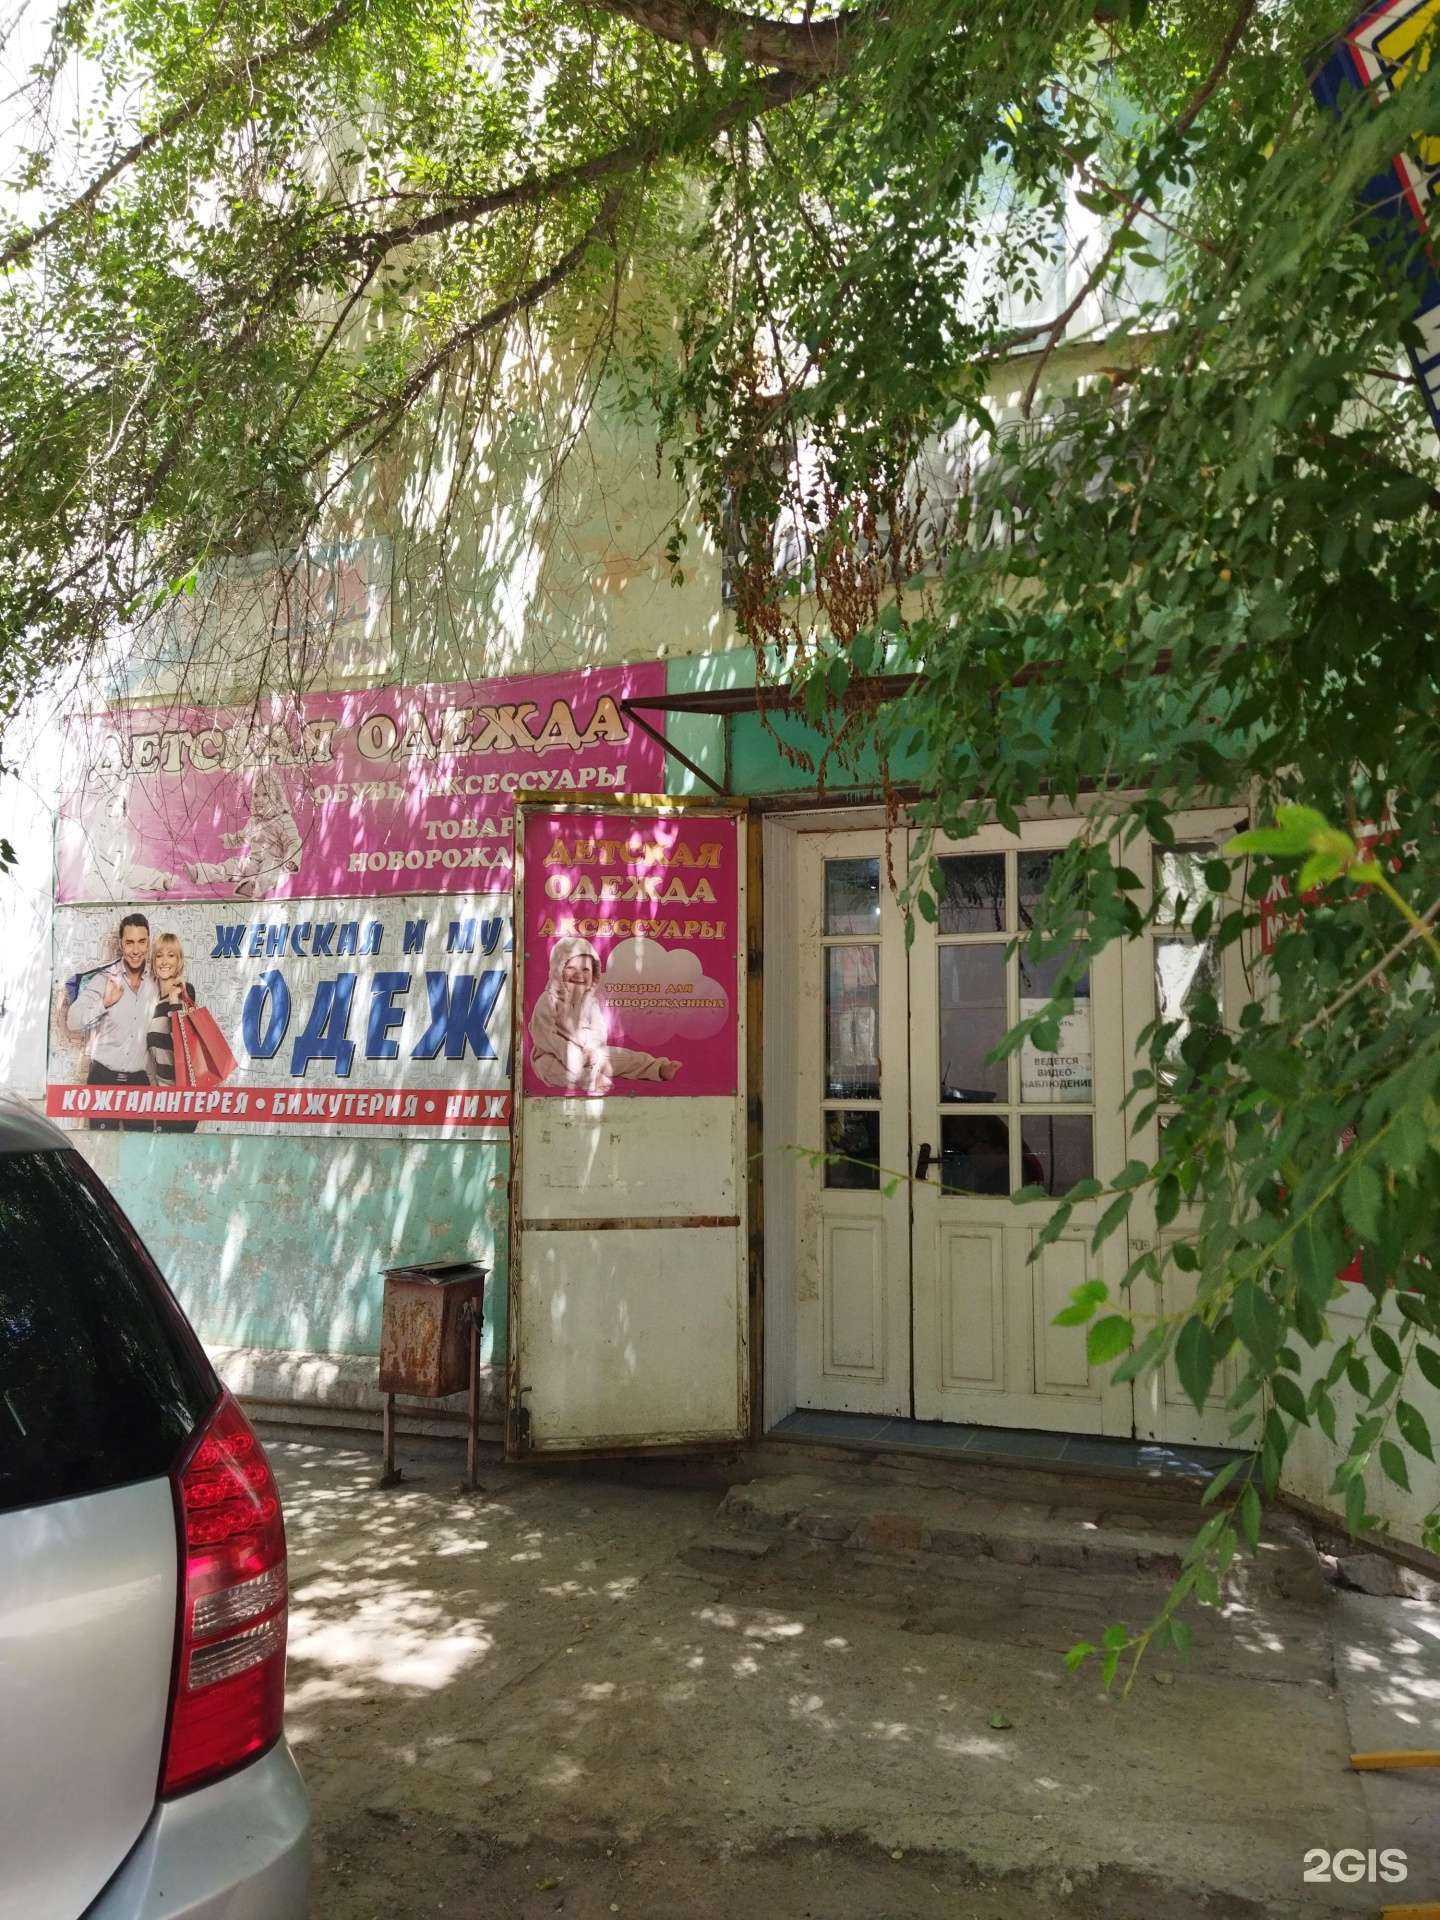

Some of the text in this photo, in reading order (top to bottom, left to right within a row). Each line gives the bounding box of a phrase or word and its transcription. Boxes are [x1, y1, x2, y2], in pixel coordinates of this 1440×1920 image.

[357, 695, 629, 762] ОДЕЖДА
[424, 765, 628, 797] АКСЕССУАРЫ
[543, 838, 724, 868] ДЕТСКАЯ
[544, 874, 717, 905] ОДЕЖДА
[210, 920, 384, 958] ЖЕНСКАЯ
[403, 919, 427, 955] И
[538, 918, 726, 940] АКСЕССУАРЫ
[61, 1088, 249, 1114] КОЖГАЛАНТЕРЕЯ
[271, 1093, 418, 1118] БИЖУТЕРИЯ
